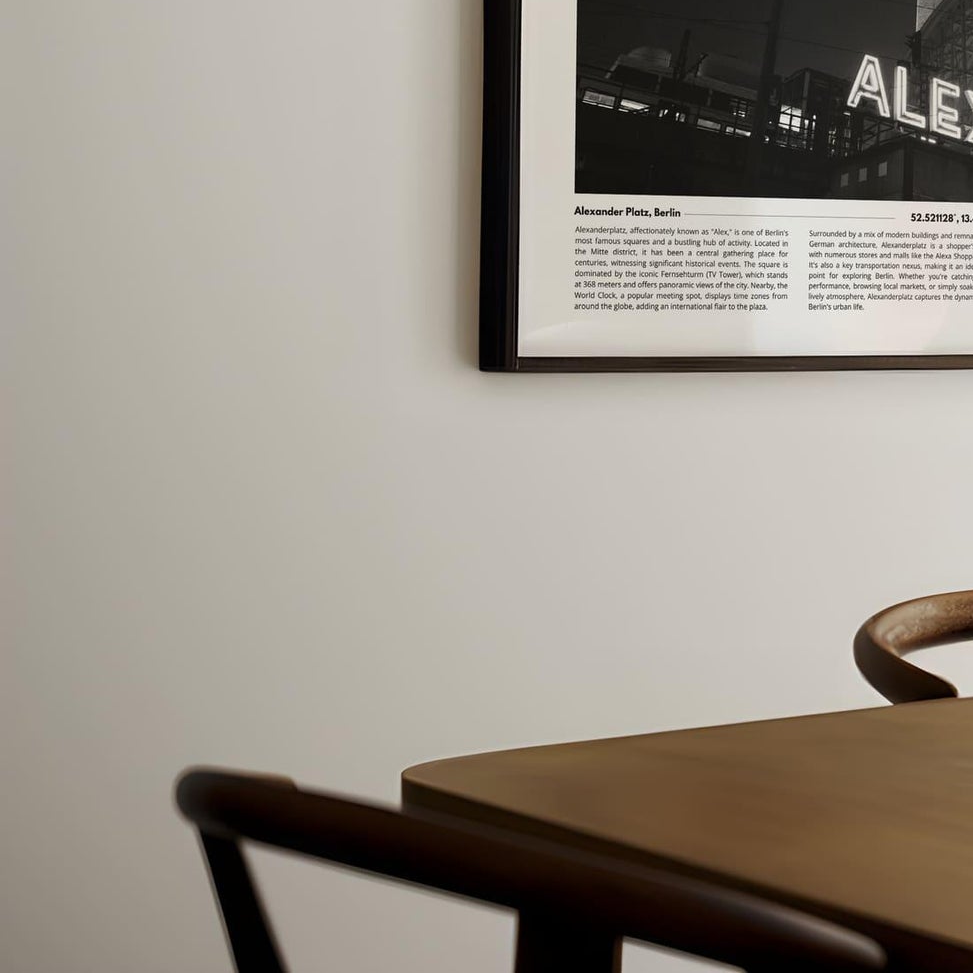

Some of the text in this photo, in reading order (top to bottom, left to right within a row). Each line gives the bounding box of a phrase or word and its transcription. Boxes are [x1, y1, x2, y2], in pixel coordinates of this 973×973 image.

[574, 206, 681, 218] Alexander Platz, Berlin
[575, 226, 628, 236] Alexanderplatz,
[630, 227, 676, 236] affectionately
[756, 228, 763, 236] of
[848, 230, 856, 239] by
[911, 231, 939, 241] buildings
[595, 237, 621, 245] famous
[623, 239, 650, 247] squares
[674, 238, 701, 247] bustling
[727, 239, 752, 248] activity.
[754, 239, 780, 247] Located
[809, 240, 835, 248] German
[838, 241, 878, 249] architecture,
[882, 241, 926, 251] Alexanderplatz
[591, 248, 609, 256] Mitte
[613, 248, 638, 257] district,
[696, 249, 719, 257] central
[723, 249, 754, 259] gathering
[758, 250, 775, 259] place
[859, 251, 878, 259] stores
[575, 259, 609, 267] centuries,
[611, 259, 647, 268] witnessing
[649, 260, 683, 269] significant
[809, 261, 818, 269] It's
[819, 261, 833, 269] also
[842, 262, 853, 271] key
[855, 262, 900, 271] transportation
[924, 263, 947, 272] making
[614, 270, 623, 279] by
[661, 270, 704, 278] Fernsehturm
[706, 271, 717, 279] (TV
[718, 271, 743, 279] Tower),
[809, 272, 825, 281] point
[842, 272, 872, 281] exploring
[875, 272, 894, 280] Berlin.
[928, 273, 947, 282] you're
[659, 281, 694, 290] panoramic
[736, 281, 749, 290] city.
[750, 281, 776, 290] Nearby,
[777, 281, 788, 289] the
[808, 282, 852, 291] performance,
[853, 282, 882, 291] browsing
[900, 283, 927, 291] markets,
[938, 283, 958, 292] simply
[596, 291, 618, 299] Clock,
[627, 291, 654, 300] popular
[656, 292, 684, 300] meeting
[686, 292, 702, 301] spot,
[705, 292, 731, 301] displays
[808, 292, 825, 301] lively
[826, 292, 866, 301] atmosphere,
[867, 292, 913, 302] Alexanderplatz
[914, 293, 941, 302] captures
[574, 302, 599, 310] around
[601, 302, 612, 310] the
[613, 302, 634, 311] globe,
[636, 302, 659, 311] adding
[749, 303, 768, 312] plaza.
